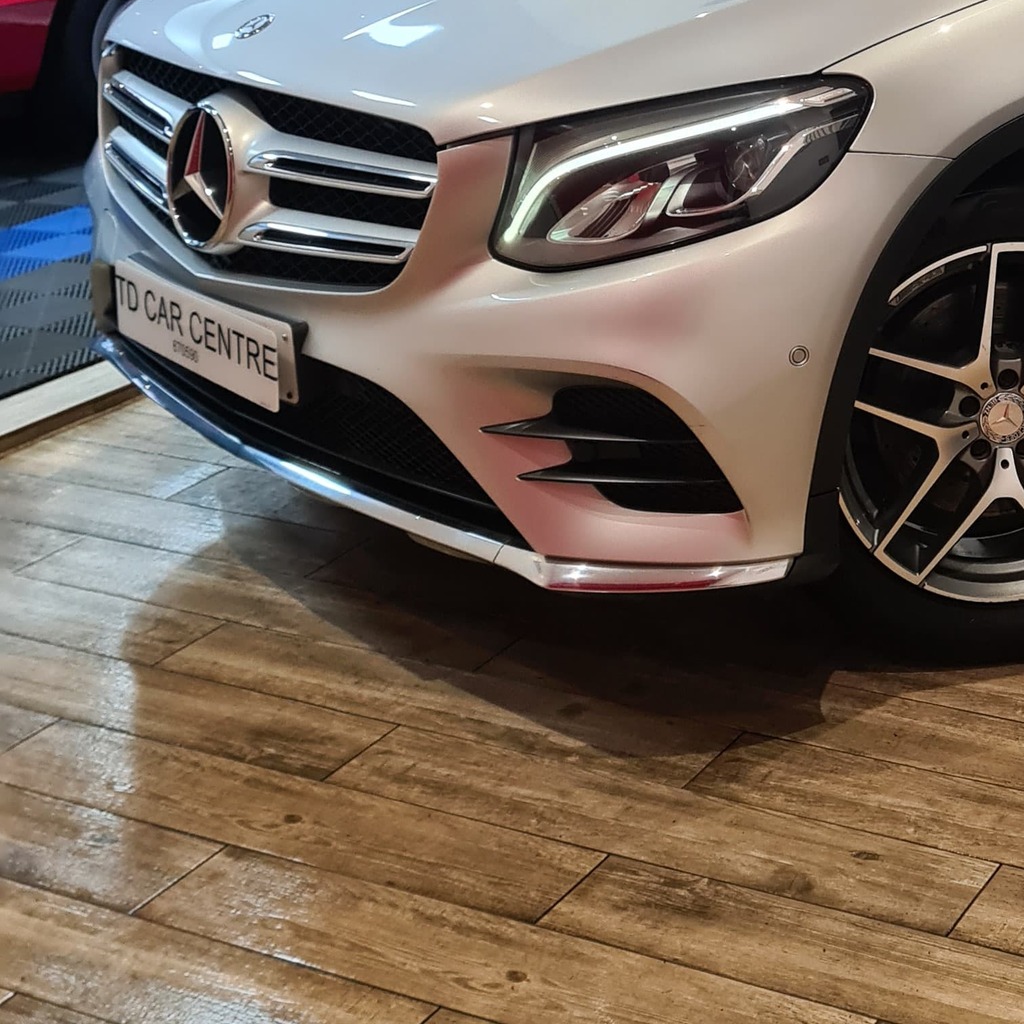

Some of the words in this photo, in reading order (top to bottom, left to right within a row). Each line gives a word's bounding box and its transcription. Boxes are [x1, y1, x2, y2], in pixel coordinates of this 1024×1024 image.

[115, 275, 139, 312] TD
[144, 289, 184, 337] CAR
[189, 311, 278, 382] CENTRE
